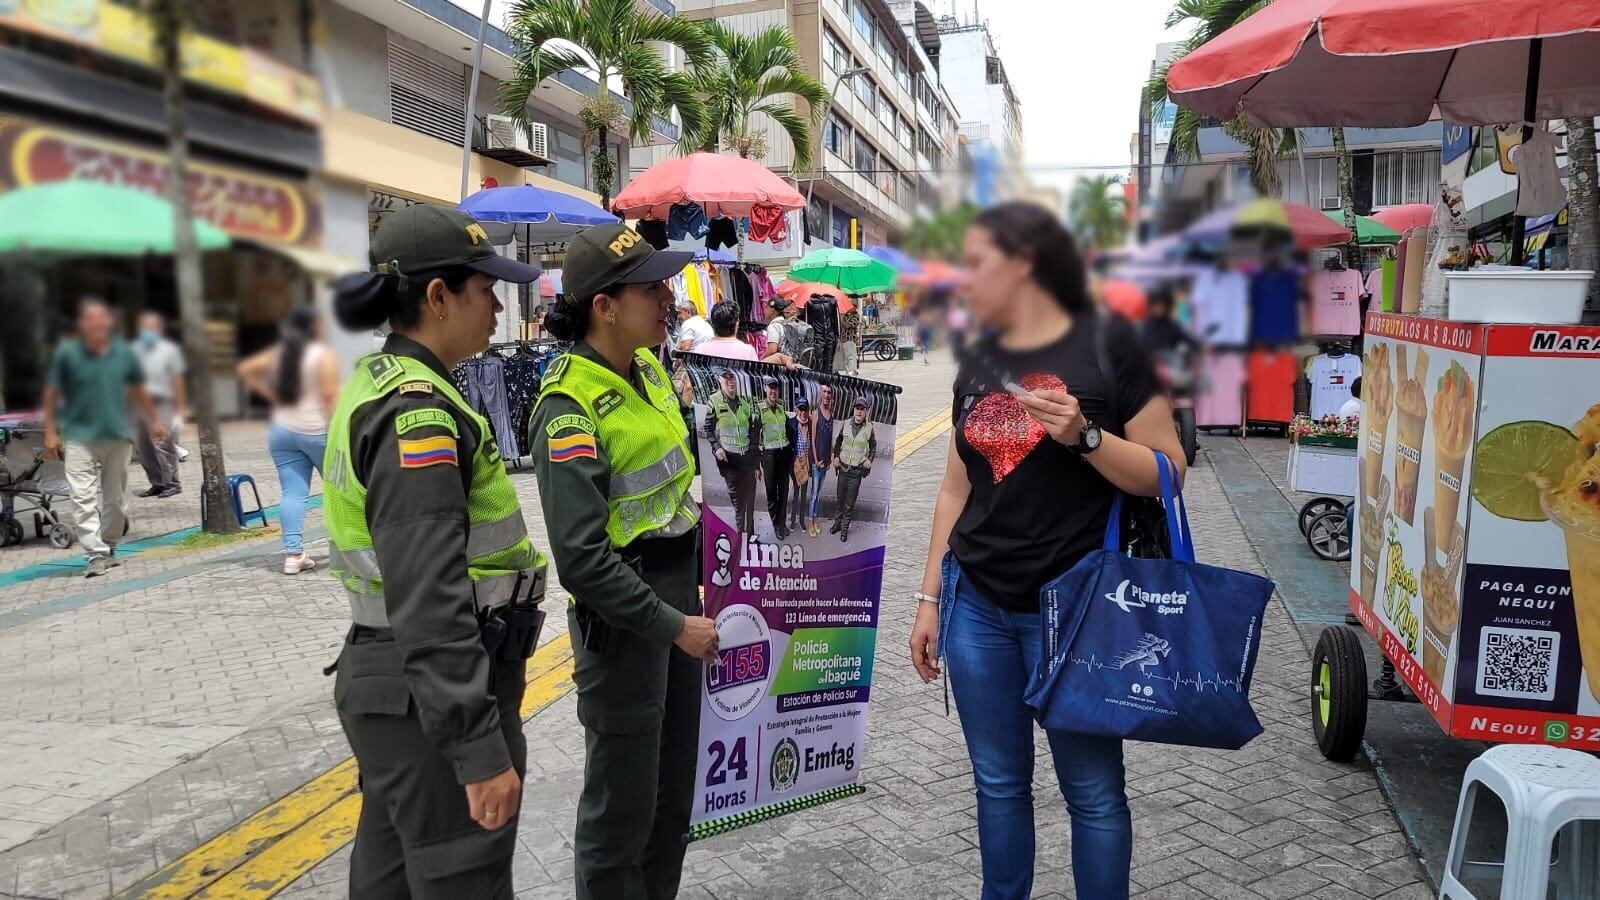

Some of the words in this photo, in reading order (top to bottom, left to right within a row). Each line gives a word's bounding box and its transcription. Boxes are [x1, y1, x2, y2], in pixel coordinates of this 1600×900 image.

[1369, 318, 1421, 340] DISFRUTALOS
[1423, 324, 1429, 341] A
[1442, 326, 1472, 349] 8.000
[739, 532, 804, 569] línea
[739, 571, 761, 591] de
[763, 572, 817, 591] Atención
[1479, 580, 1525, 593] PAGA
[1534, 584, 1571, 596] CON
[761, 598, 775, 607] Una
[775, 598, 797, 608] llamada
[798, 598, 816, 609] puede
[816, 598, 833, 607] hacer
[833, 597, 839, 607] la
[839, 597, 873, 608] diferencia
[1131, 585, 1187, 605] Planeta
[1498, 596, 1556, 610] NEQUI
[785, 613, 797, 624] 123
[798, 611, 817, 623] Línea
[817, 612, 826, 622] de
[827, 611, 871, 624] emergencia
[1157, 605, 1184, 615] Sport
[1492, 616, 1514, 624] JUAN
[1514, 617, 1552, 627] SANCHEZ
[793, 639, 829, 656] Policía
[721, 643, 764, 683] 155
[792, 654, 862, 672] Metropolitana
[824, 667, 861, 685] Ibagué
[1385, 634, 1399, 660] 320
[1400, 654, 1416, 681] 821
[1417, 676, 1439, 712] 5150
[783, 694, 811, 708] Estación
[812, 693, 822, 702] de
[845, 689, 858, 699] Sur
[808, 715, 815, 723] de
[814, 712, 839, 722] Protección
[847, 709, 862, 719] Mujer
[815, 723, 833, 733] Género
[1470, 717, 1537, 736] NEQUI
[1570, 726, 1600, 742] 32
[705, 736, 749, 787] 24
[804, 742, 855, 773] Emfag
[705, 789, 746, 813] Horas
